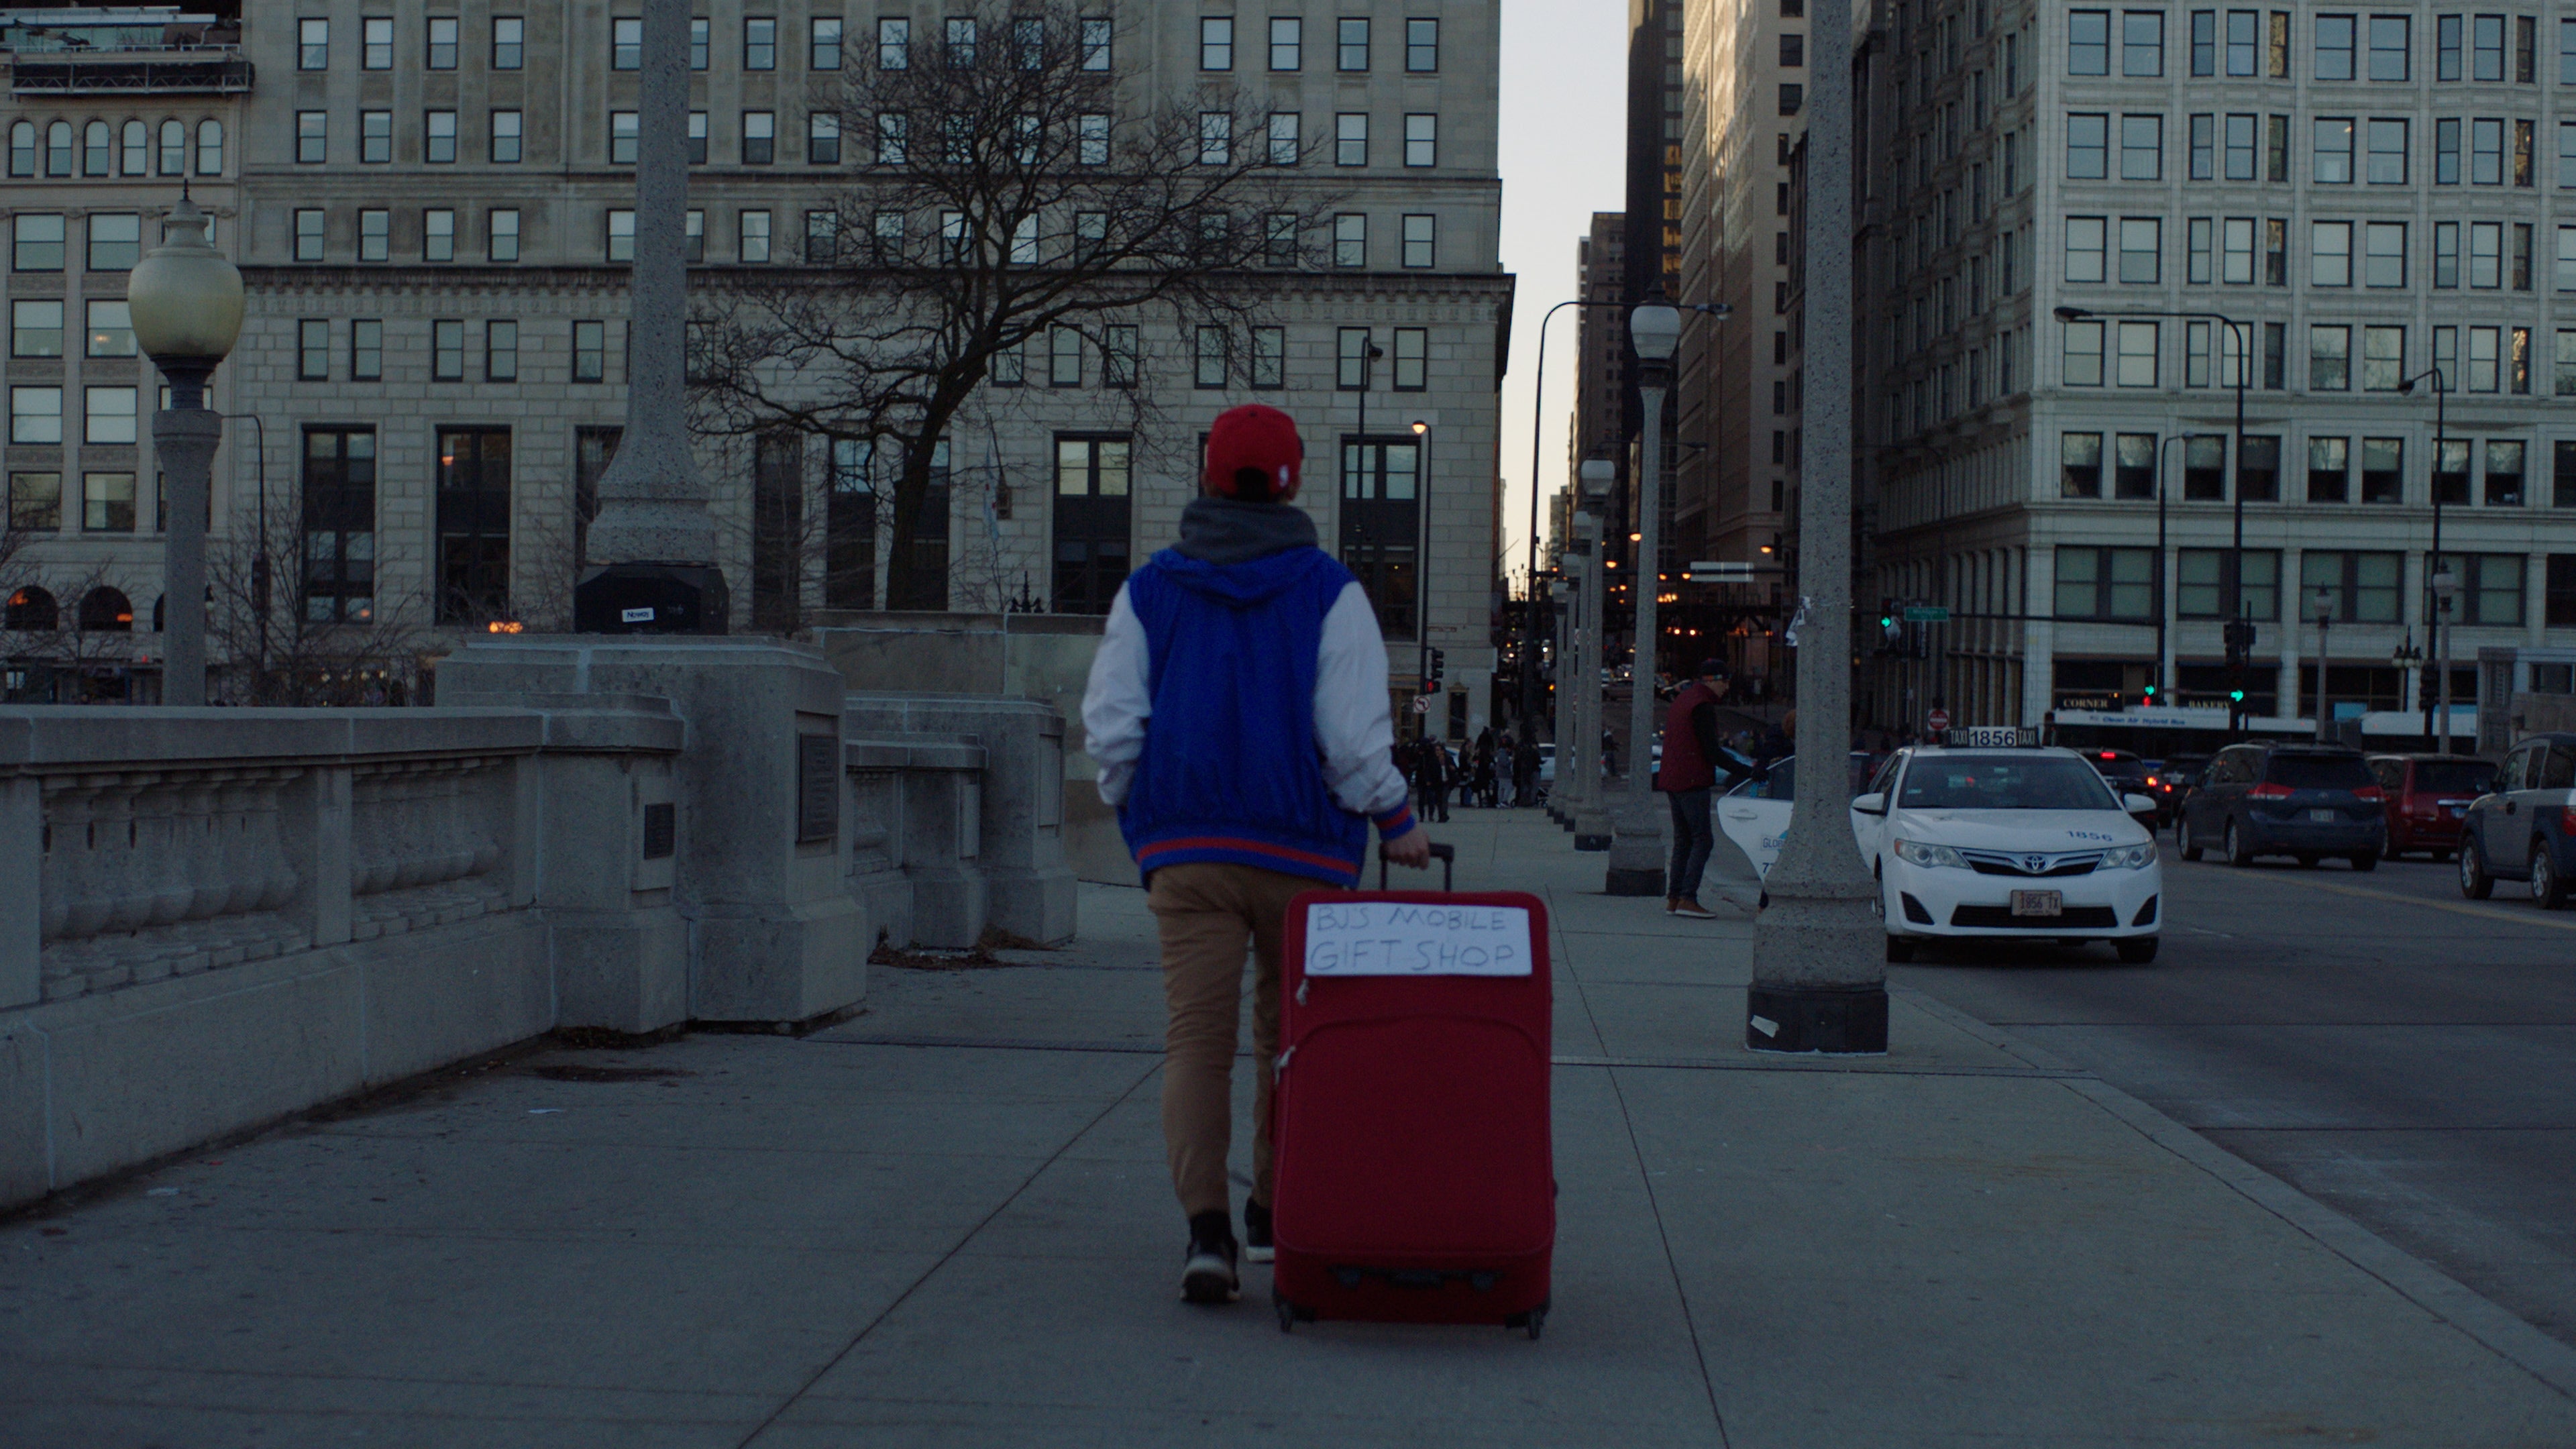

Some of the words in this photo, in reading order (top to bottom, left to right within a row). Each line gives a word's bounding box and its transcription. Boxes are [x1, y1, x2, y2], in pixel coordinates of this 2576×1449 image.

[2063, 698, 2108, 708] CORNER
[2188, 700, 2230, 709] BAKERY
[1951, 730, 1968, 746] TAXI
[1970, 731, 2015, 746] 1856
[2018, 730, 2035, 746] TAXI
[2067, 830, 2112, 841] 1856
[2021, 897, 2043, 909] 1856
[1387, 906, 1506, 930] MOBILE
[1311, 940, 1402, 970] GIFT
[1411, 941, 1515, 971] SHOP
